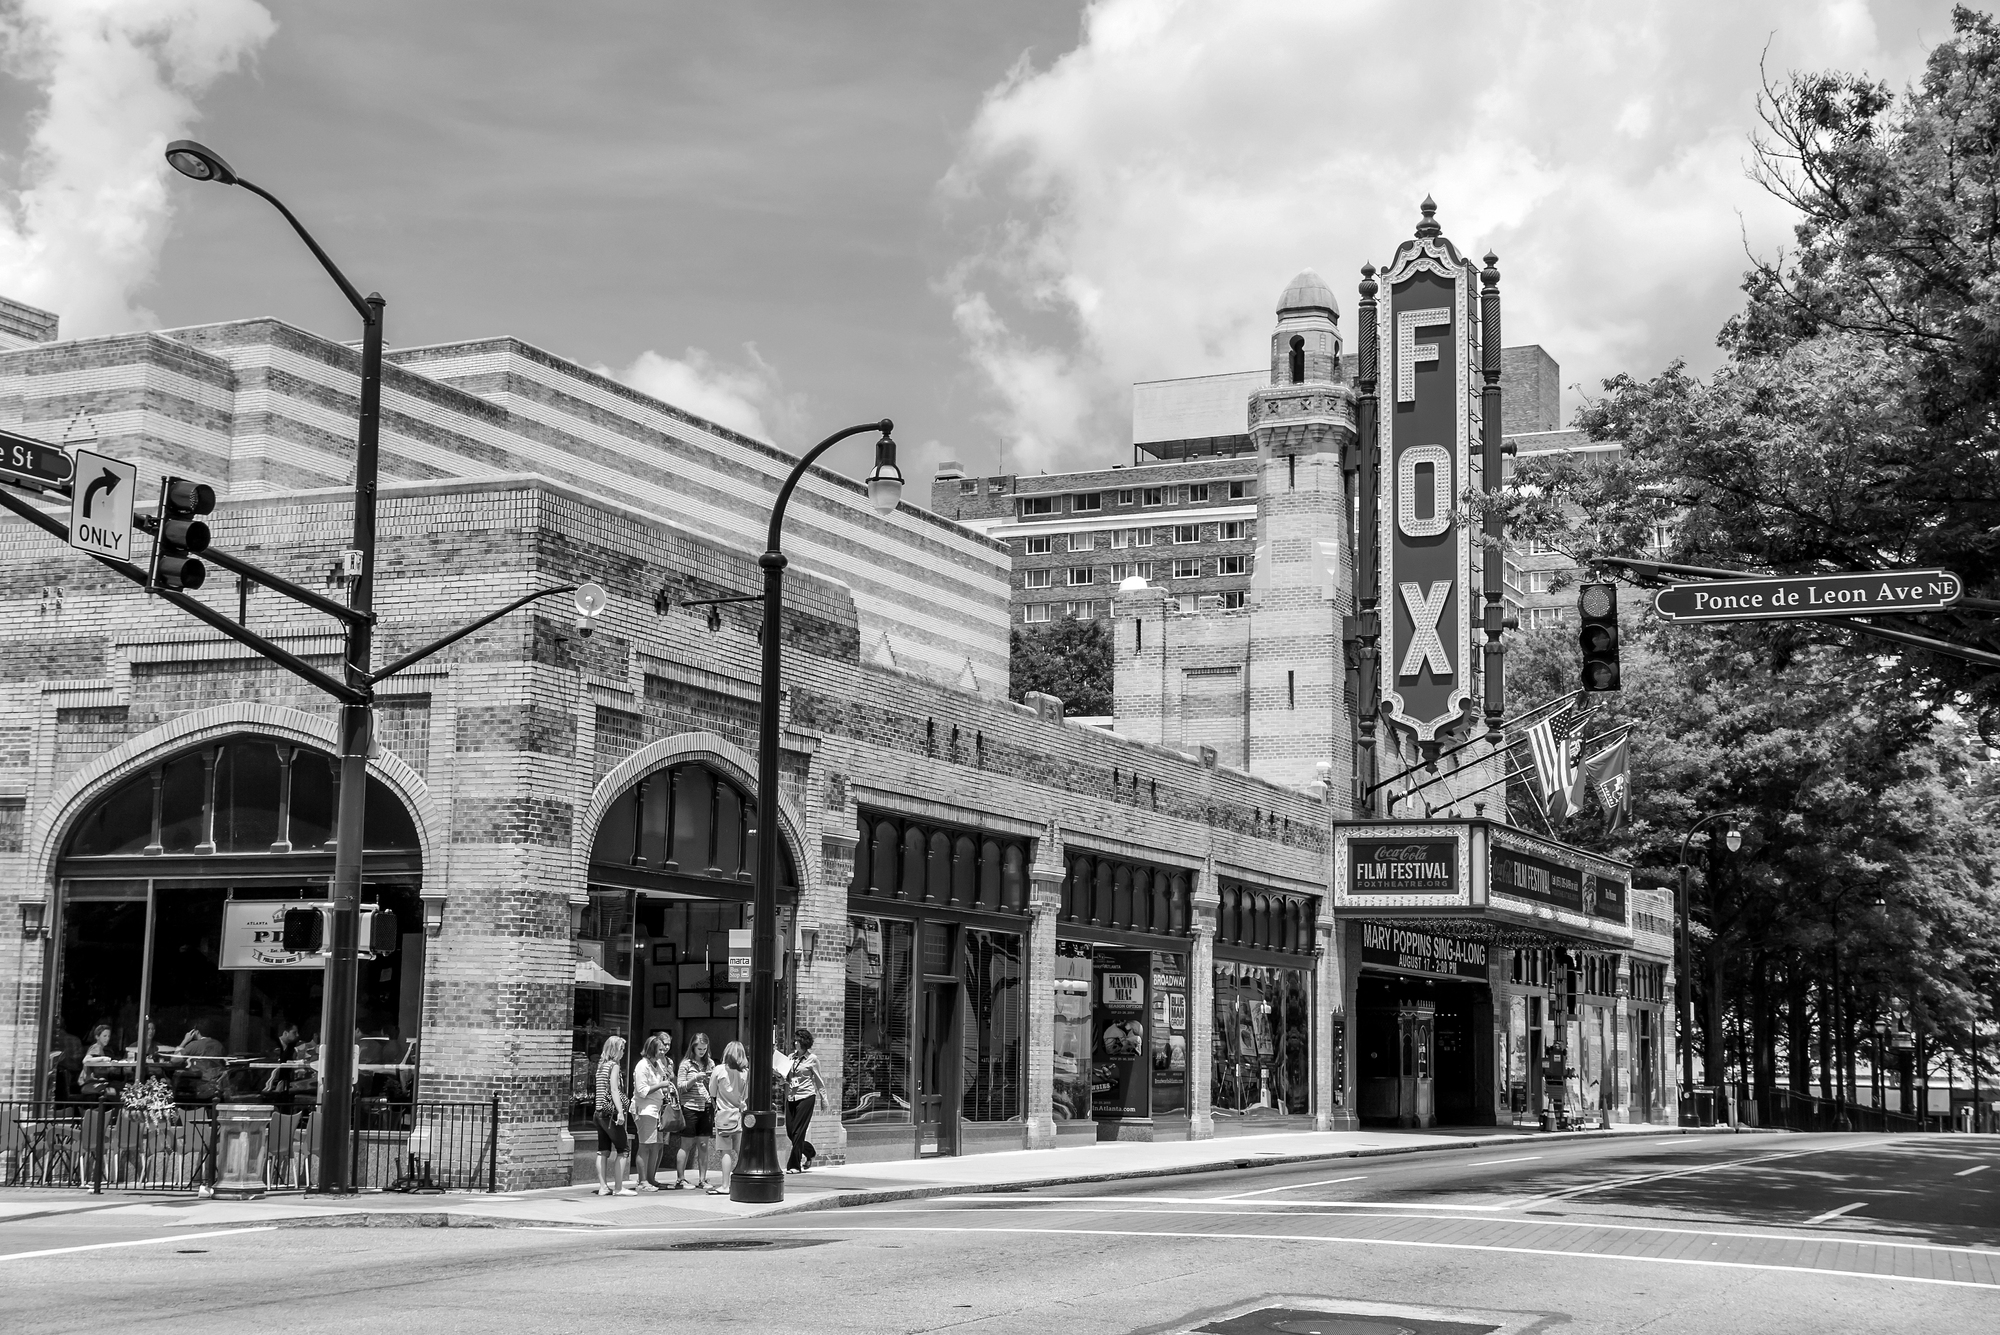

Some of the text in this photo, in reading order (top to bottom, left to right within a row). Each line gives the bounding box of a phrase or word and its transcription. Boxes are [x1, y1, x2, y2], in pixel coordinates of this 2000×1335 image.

[12, 445, 34, 469] St
[1397, 307, 1453, 677] FOX
[79, 524, 122, 550] ONLY
[1695, 581, 1954, 610] Ponce de Leon Ave NE
[1374, 845, 1430, 861] Coca-Cola
[1356, 862, 1449, 879] FILM FESTIVAL
[1513, 861, 1528, 890] FILM
[1527, 865, 1551, 895] FESTIVAL
[1357, 880, 1448, 888] FOXTHEATRE.ORG
[1363, 923, 1486, 966] MARY POPPINS SING-A-LONG
[1399, 954, 1422, 970] AUGUST
[1423, 957, 1431, 971] 17
[1436, 959, 1448, 973] 2:00
[1449, 961, 1457, 975] PM
[1109, 976, 1137, 989] MAMMA
[1153, 974, 1186, 987] BROADWAY
[1115, 988, 1132, 1000] MIA!
[1171, 996, 1184, 1006] BLUE
[1171, 1006, 1185, 1018] MAN
[1171, 1018, 1185, 1026] GROUP
